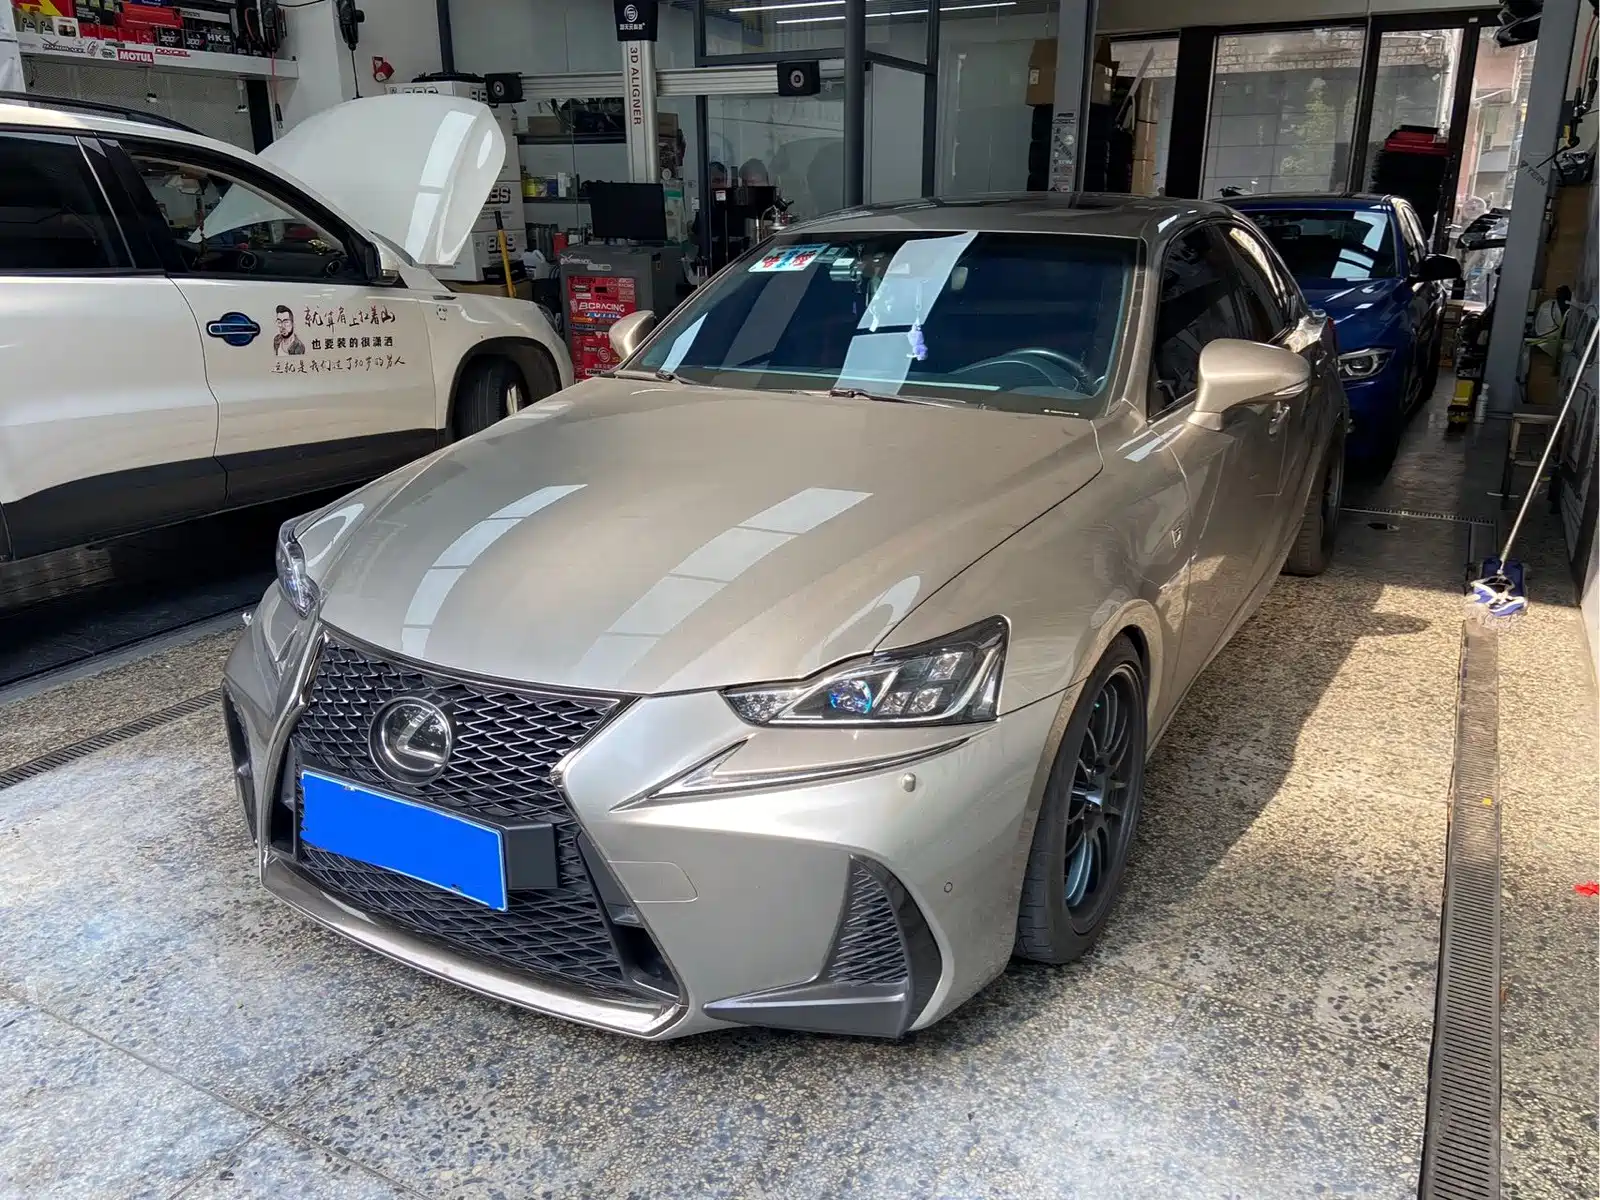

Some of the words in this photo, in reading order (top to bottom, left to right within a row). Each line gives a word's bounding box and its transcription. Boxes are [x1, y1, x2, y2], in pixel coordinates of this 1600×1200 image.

[206, 33, 231, 43] HKS
[119, 50, 153, 63] MOTUL
[630, 47, 639, 64] 3D
[631, 67, 641, 125] ALIGNER
[487, 234, 516, 254] BS
[311, 336, 394, 351] 也要装的很潇洒
